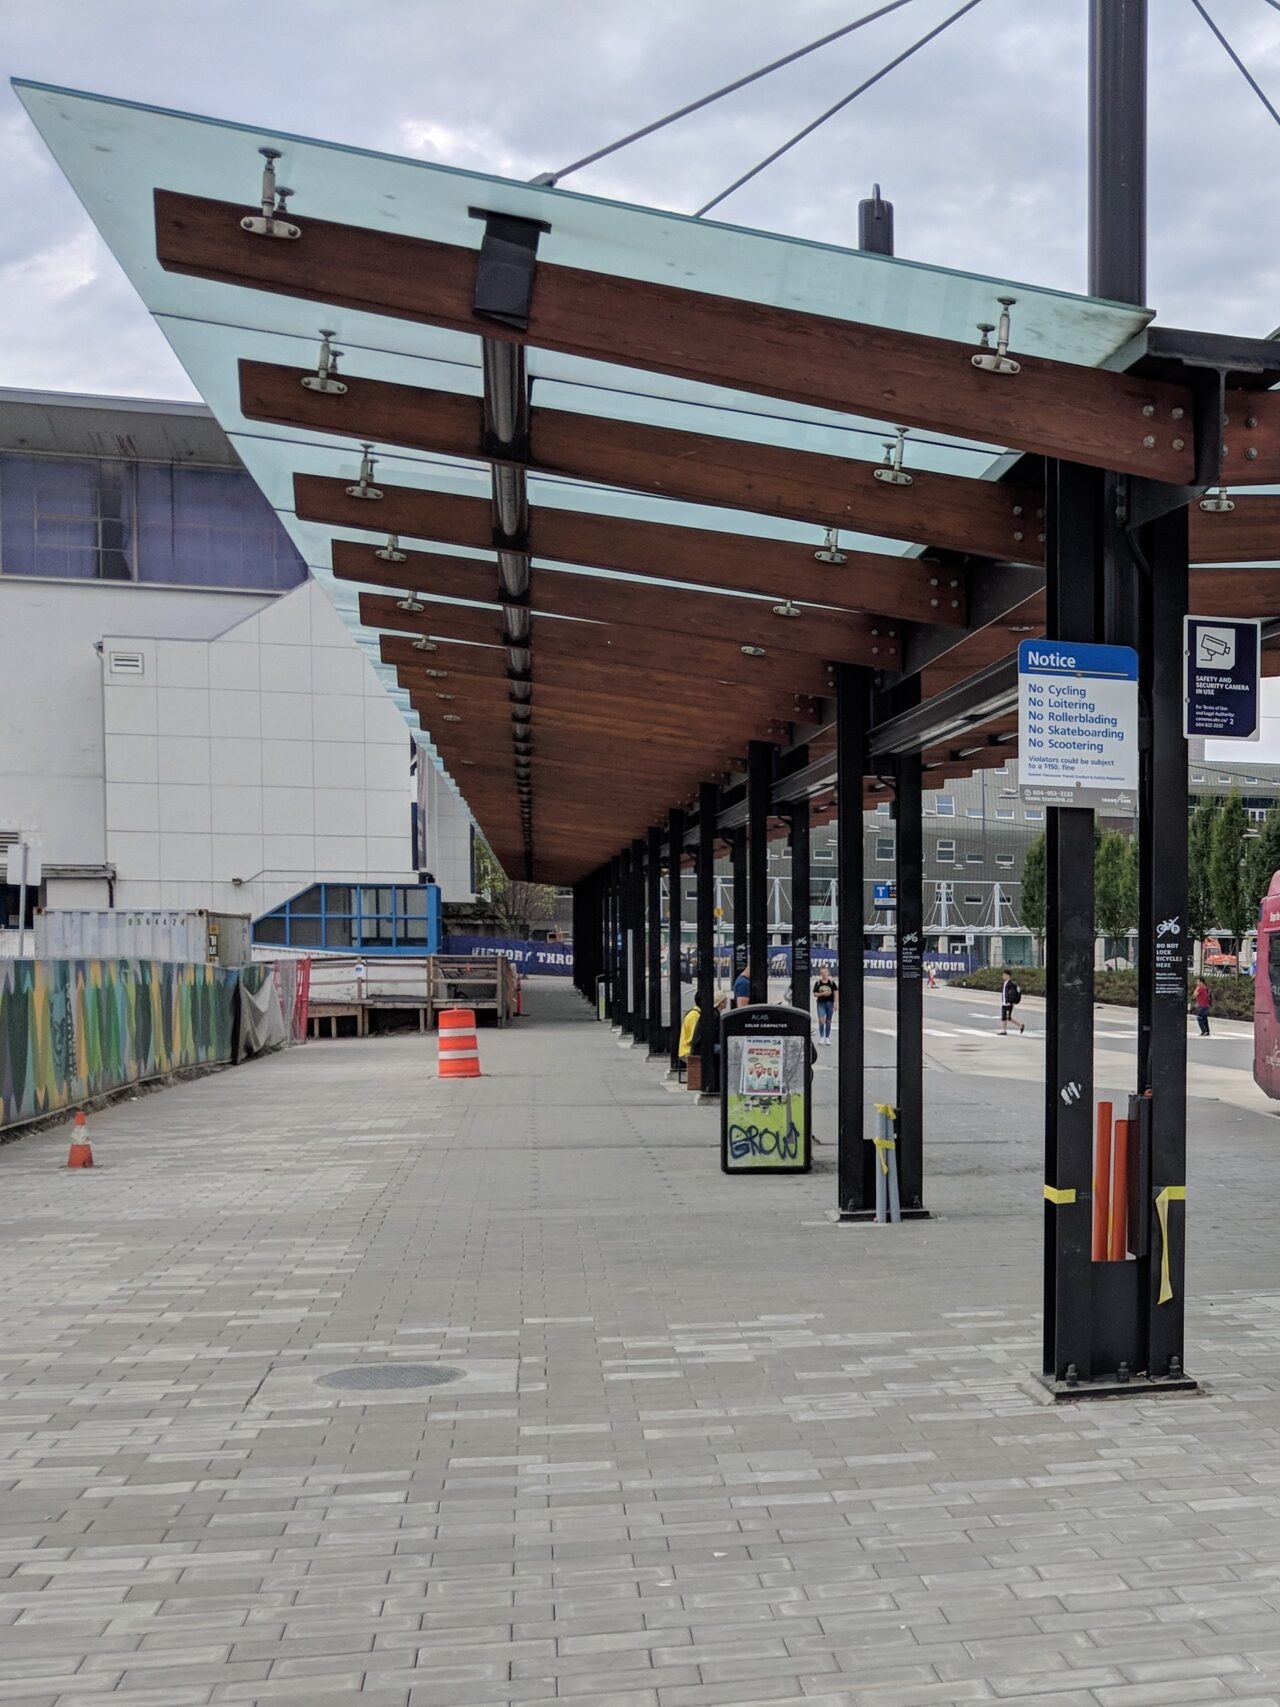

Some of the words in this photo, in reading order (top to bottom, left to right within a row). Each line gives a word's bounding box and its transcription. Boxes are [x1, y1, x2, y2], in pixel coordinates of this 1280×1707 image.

[1028, 651, 1076, 668] Notice
[1028, 684, 1043, 693] No
[1049, 685, 1086, 698] Cycling
[1028, 697, 1043, 707] No
[1049, 698, 1095, 712] Loitering
[1028, 711, 1043, 720] No
[1049, 712, 1117, 727] Rollerblading
[1028, 725, 1043, 735] No
[1048, 726, 1124, 741] Skateboarding
[1028, 738, 1043, 747] No
[1048, 739, 1103, 753] Scootering
[1091, 759, 1114, 767] subject
[811, 958, 838, 967] VICT
